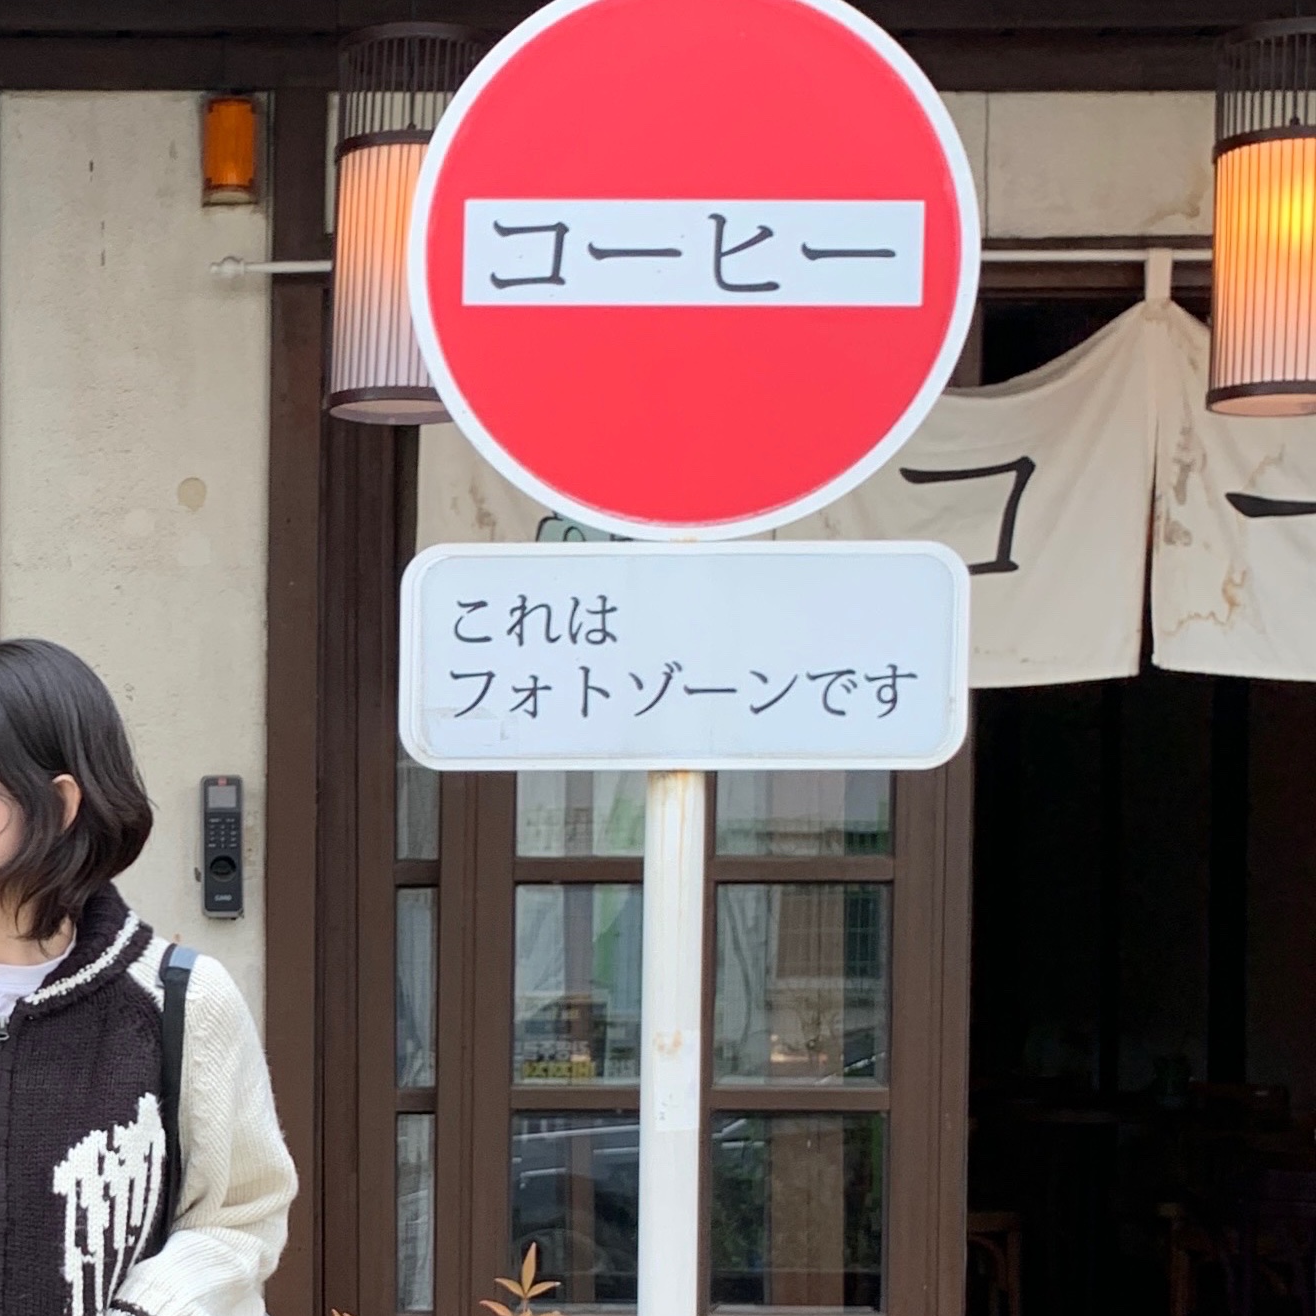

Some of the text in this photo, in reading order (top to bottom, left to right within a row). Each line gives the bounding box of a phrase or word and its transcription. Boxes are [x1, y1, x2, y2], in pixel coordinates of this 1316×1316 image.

[489, 212, 896, 293] コーヒー
[452, 593, 619, 647] これは
[449, 661, 919, 720] フォトゾーンです
